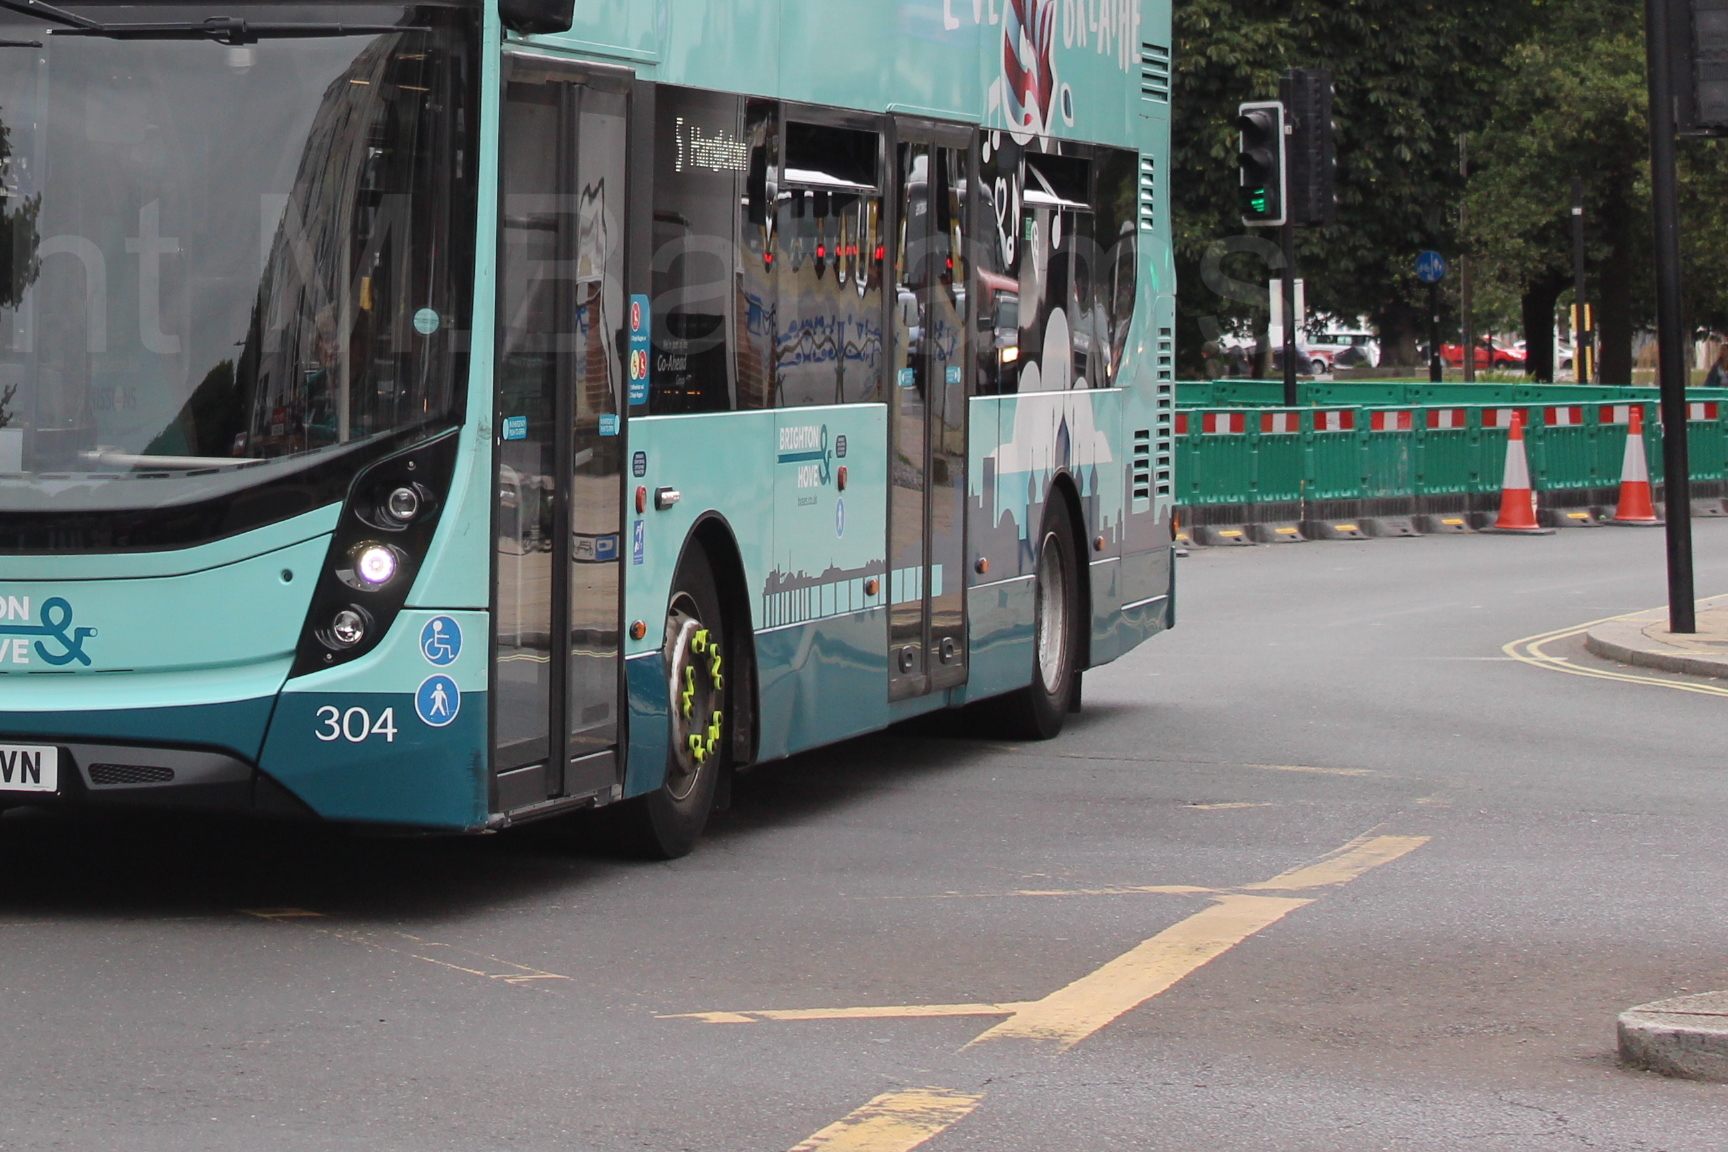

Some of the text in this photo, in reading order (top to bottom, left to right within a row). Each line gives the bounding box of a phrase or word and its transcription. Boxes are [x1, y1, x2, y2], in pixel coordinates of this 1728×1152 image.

[779, 426, 819, 450] BRIGHTON
[798, 465, 819, 488] HOVE
[313, 704, 399, 746] 304
